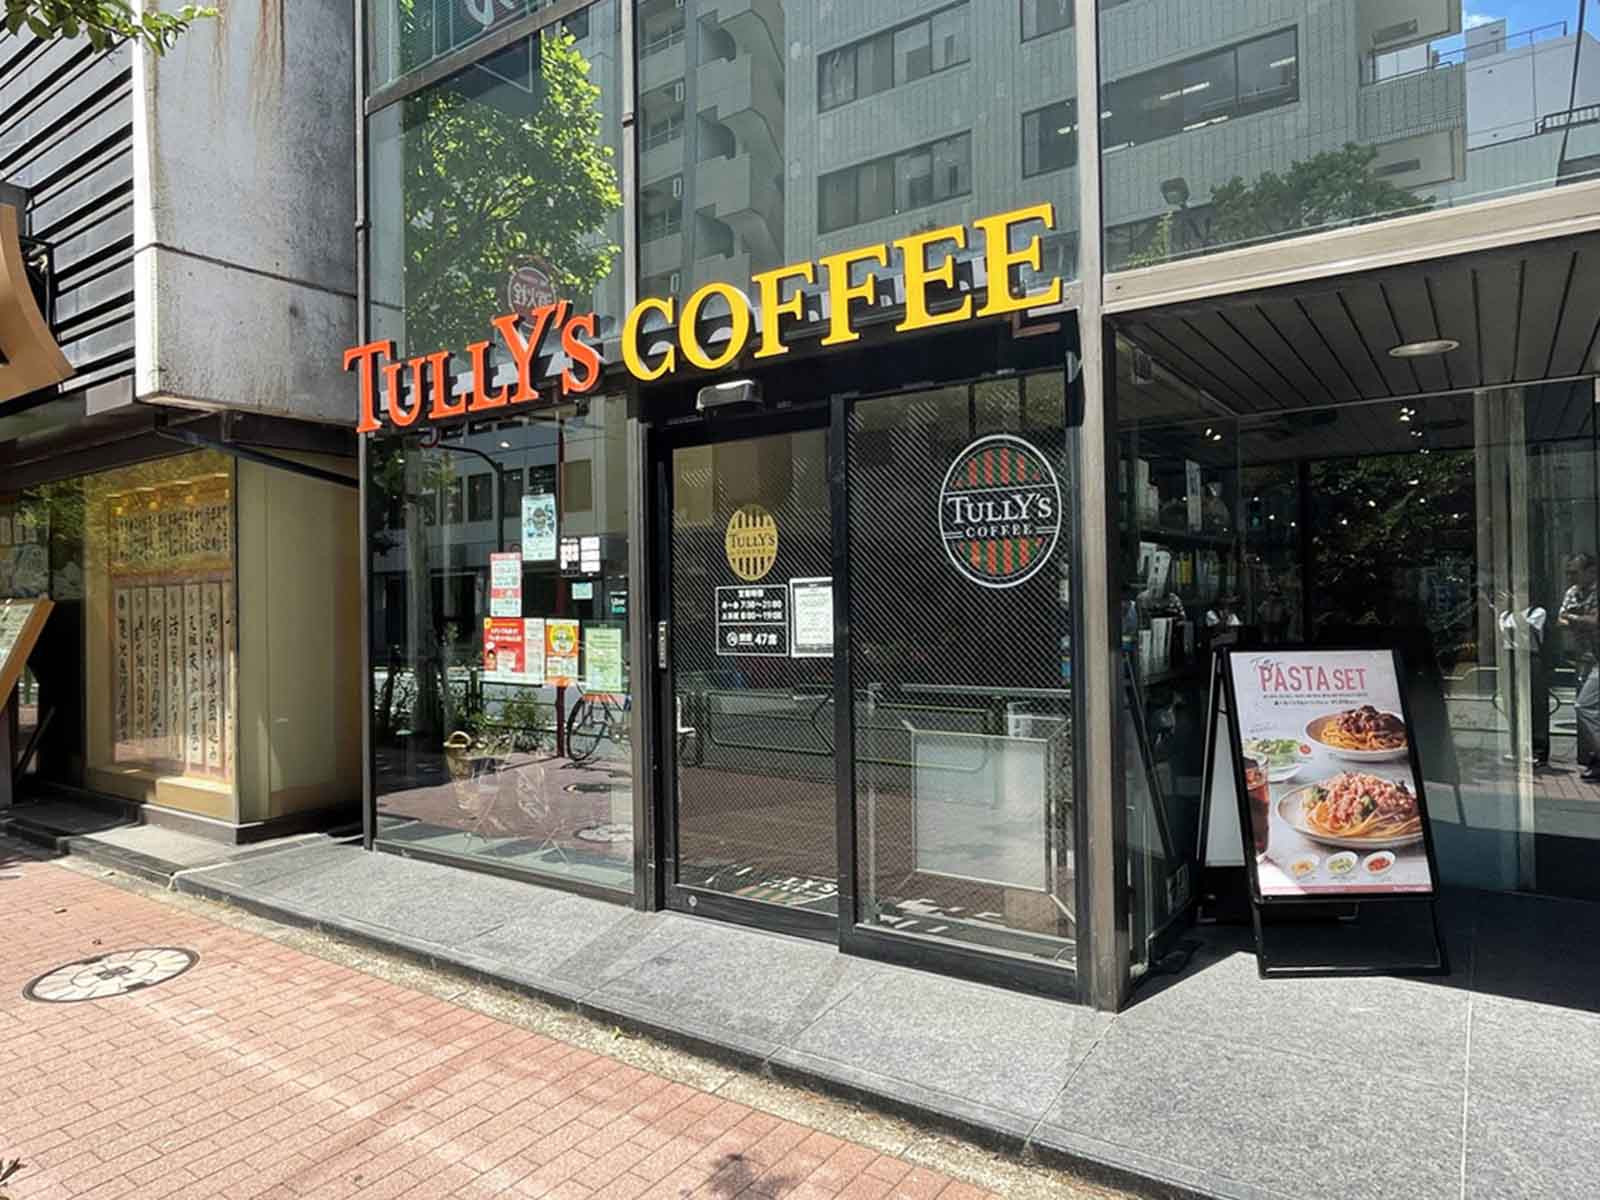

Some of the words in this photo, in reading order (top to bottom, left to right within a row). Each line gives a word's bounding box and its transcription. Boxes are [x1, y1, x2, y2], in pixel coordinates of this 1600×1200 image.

[344, 299, 601, 433] TULLY'S
[622, 203, 1062, 381] COFFEE
[946, 493, 1053, 524] TULLY'S
[965, 524, 1034, 538] COFFEE
[1258, 665, 1330, 692] PASTA
[1333, 668, 1367, 691] SET
